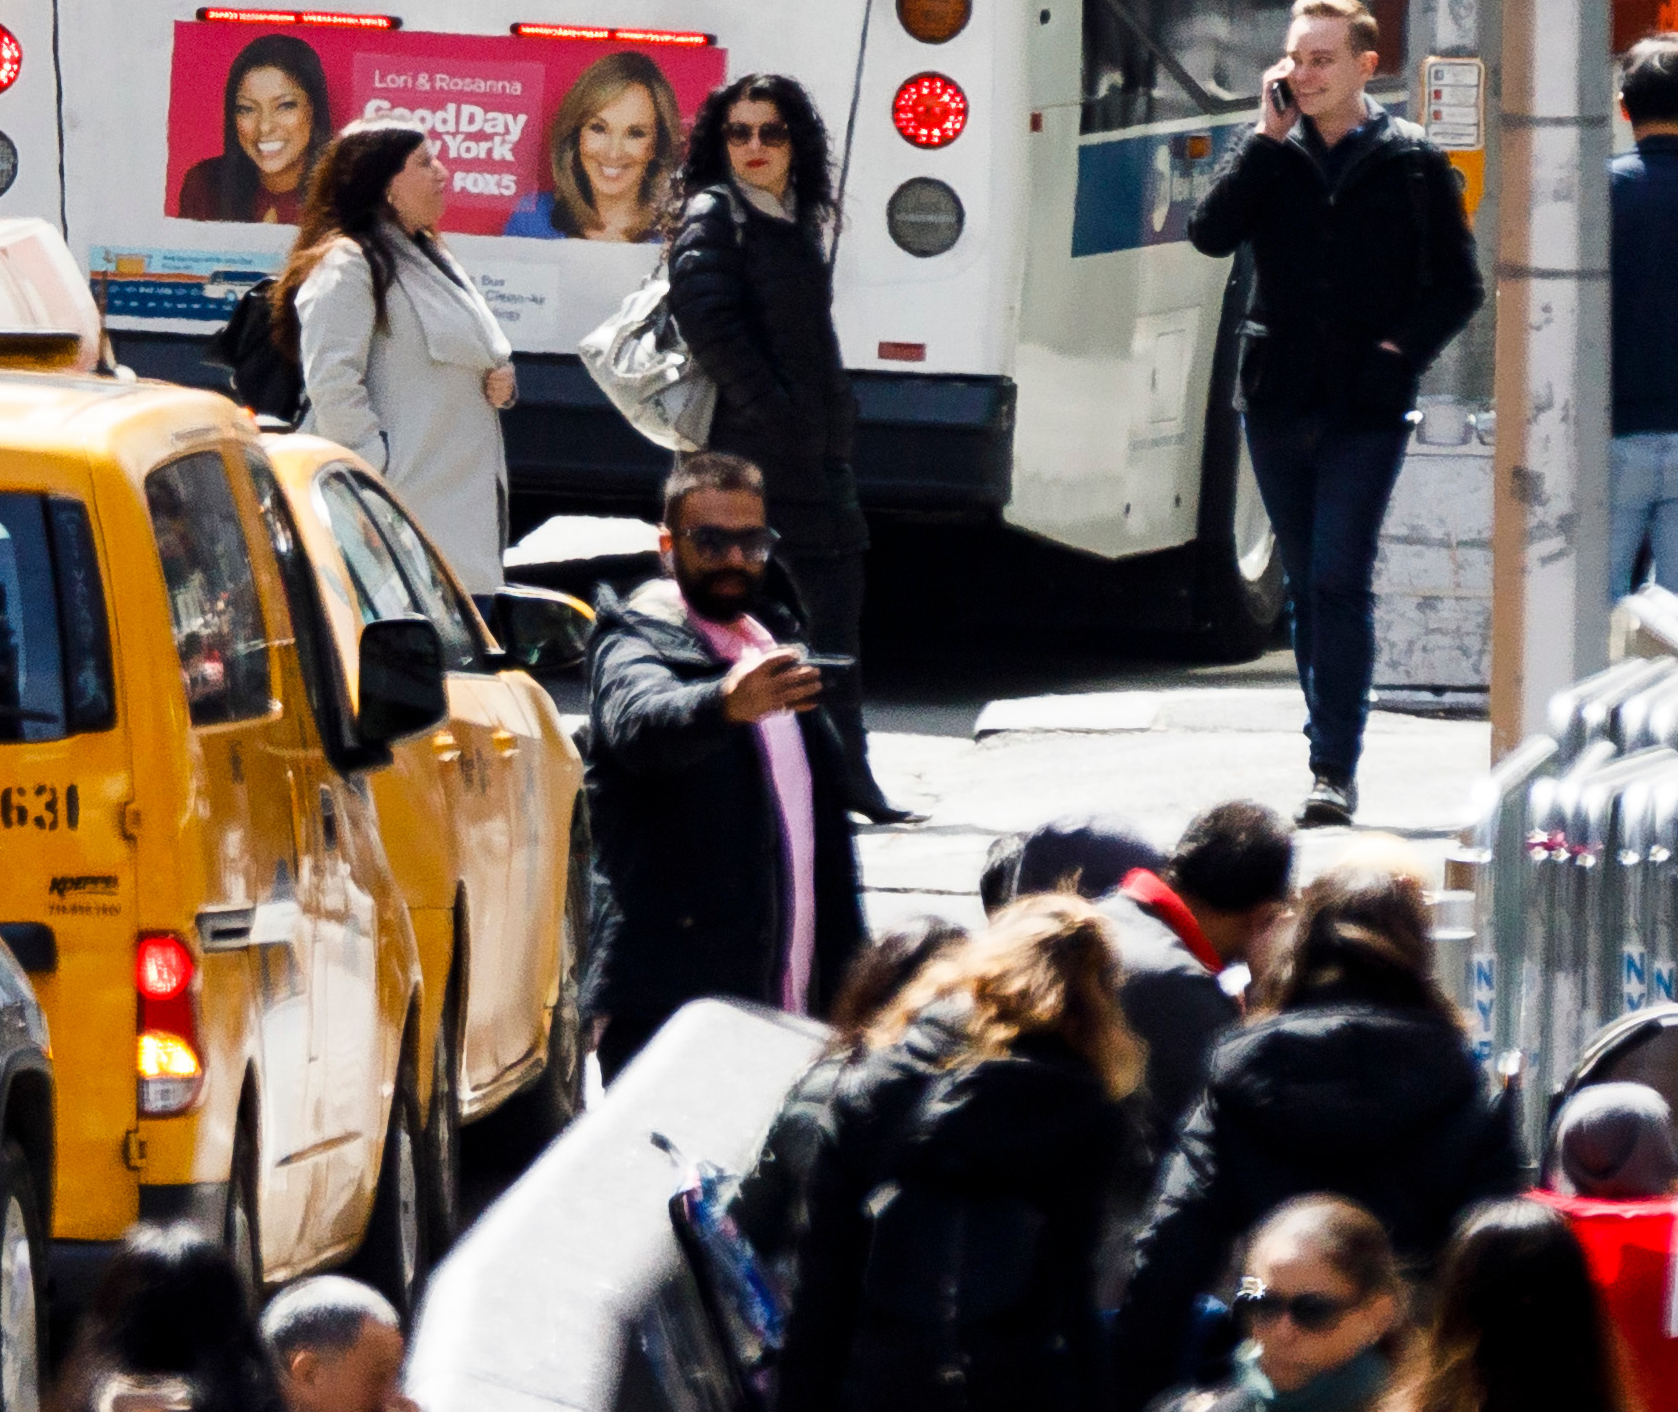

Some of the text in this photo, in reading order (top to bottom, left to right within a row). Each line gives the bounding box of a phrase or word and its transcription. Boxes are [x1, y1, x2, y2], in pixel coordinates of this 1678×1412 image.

[373, 68, 524, 96] Lori & Rosanna
[442, 133, 517, 163] York
[452, 171, 518, 197] FOX5
[0, 783, 80, 831] 631
